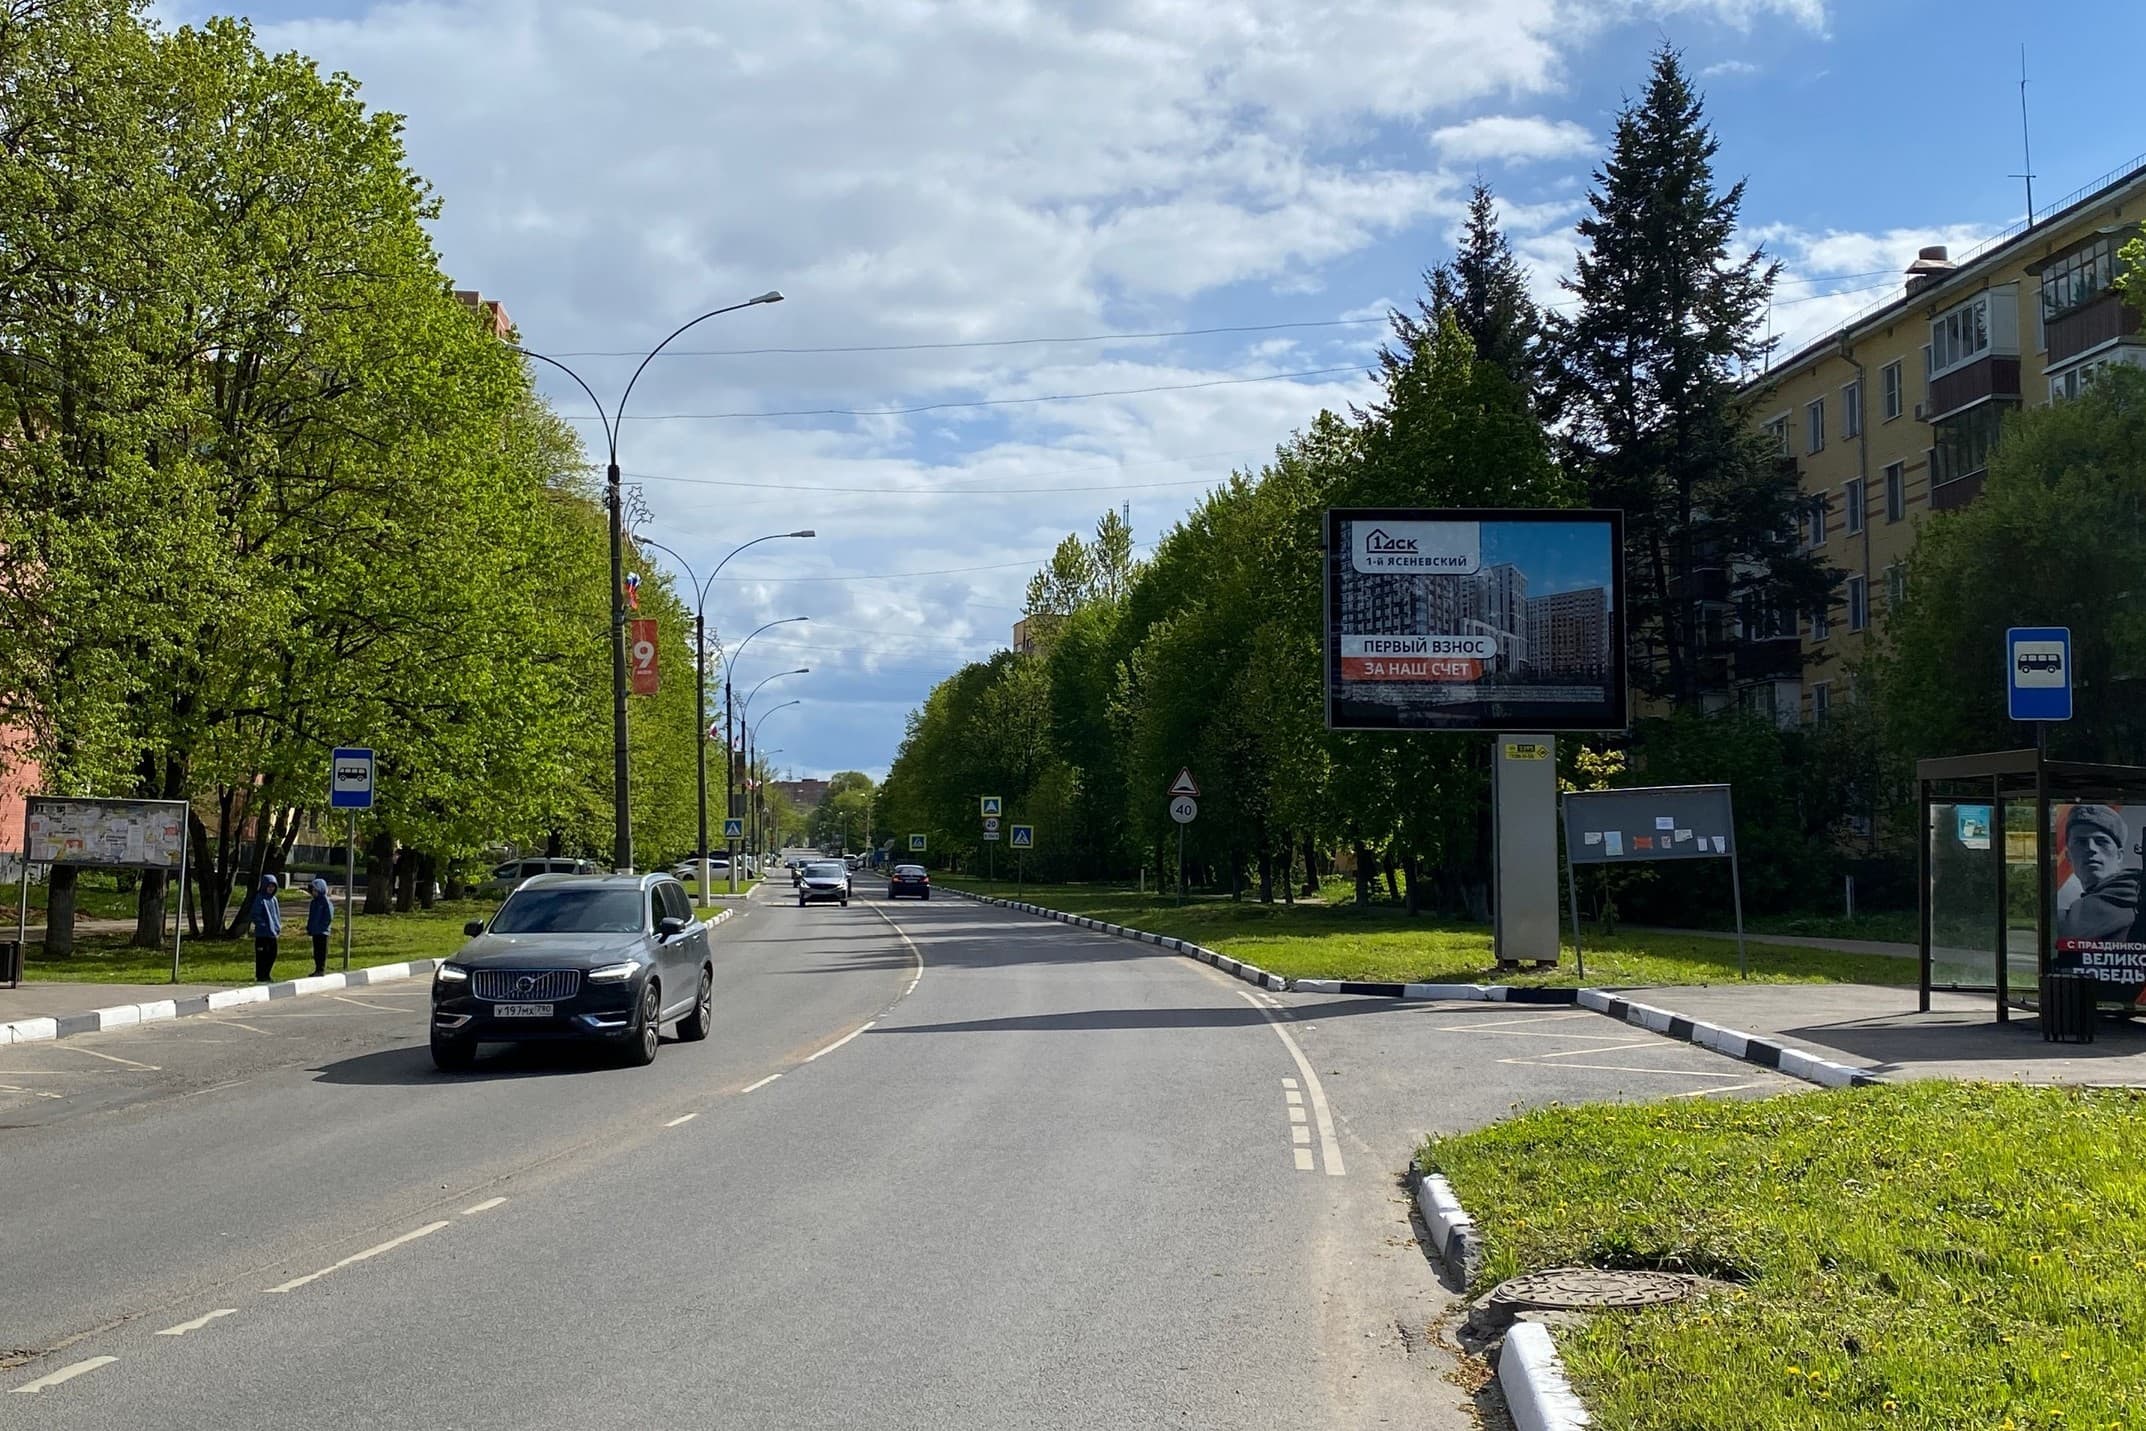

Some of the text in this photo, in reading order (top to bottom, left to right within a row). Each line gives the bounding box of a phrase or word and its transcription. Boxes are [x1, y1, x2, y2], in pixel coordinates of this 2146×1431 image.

[1387, 555, 1467, 566] ЯСЕНЕВСКИЙ
[1364, 637, 1484, 653] ПЕРВЫЙ ВЗНОС
[634, 640, 655, 669] 9
[1364, 663, 1469, 676] ЗА НАШ СЧЕТ
[1176, 805, 1192, 816] 40
[2067, 940, 2075, 949] С
